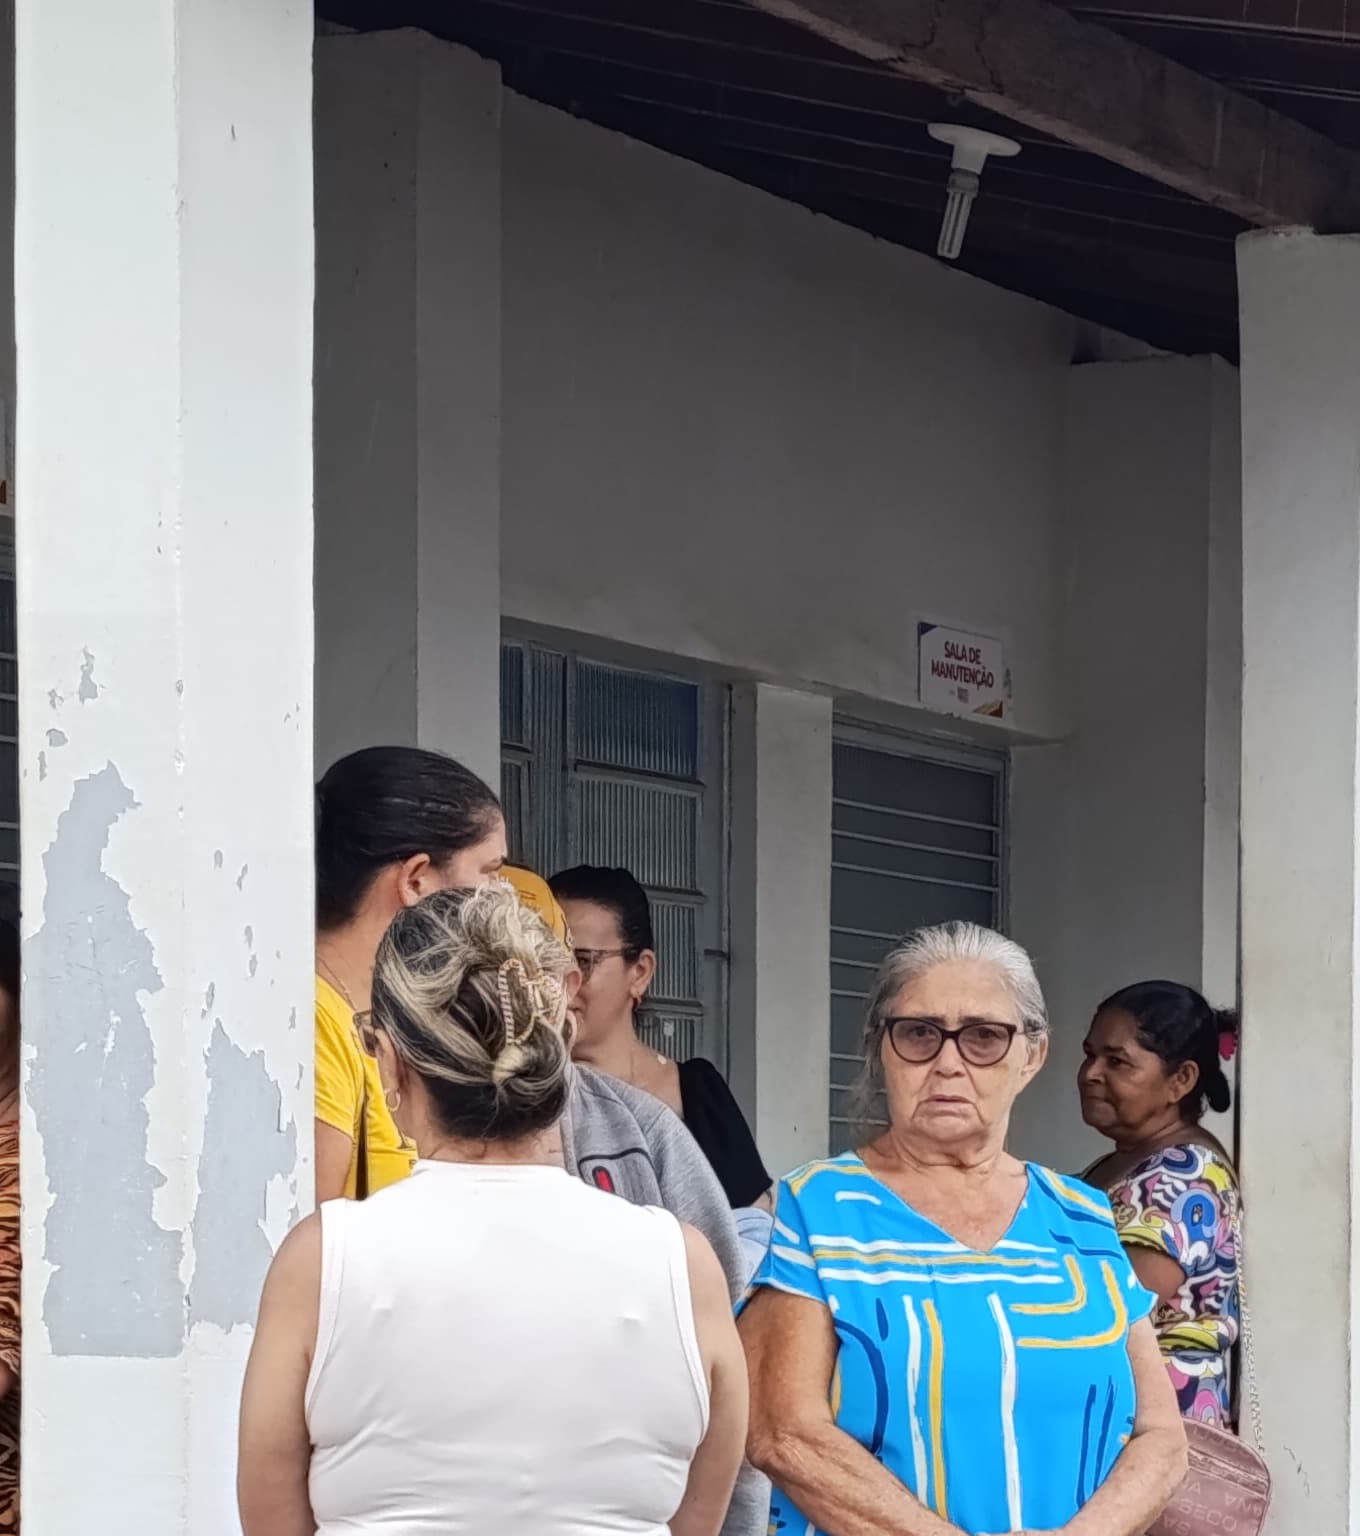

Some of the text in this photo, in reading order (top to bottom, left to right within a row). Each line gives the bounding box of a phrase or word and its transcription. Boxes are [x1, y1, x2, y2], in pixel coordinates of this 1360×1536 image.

[944, 641, 981, 665] SALA DE
[931, 658, 995, 690] MANUTENÇÃO
